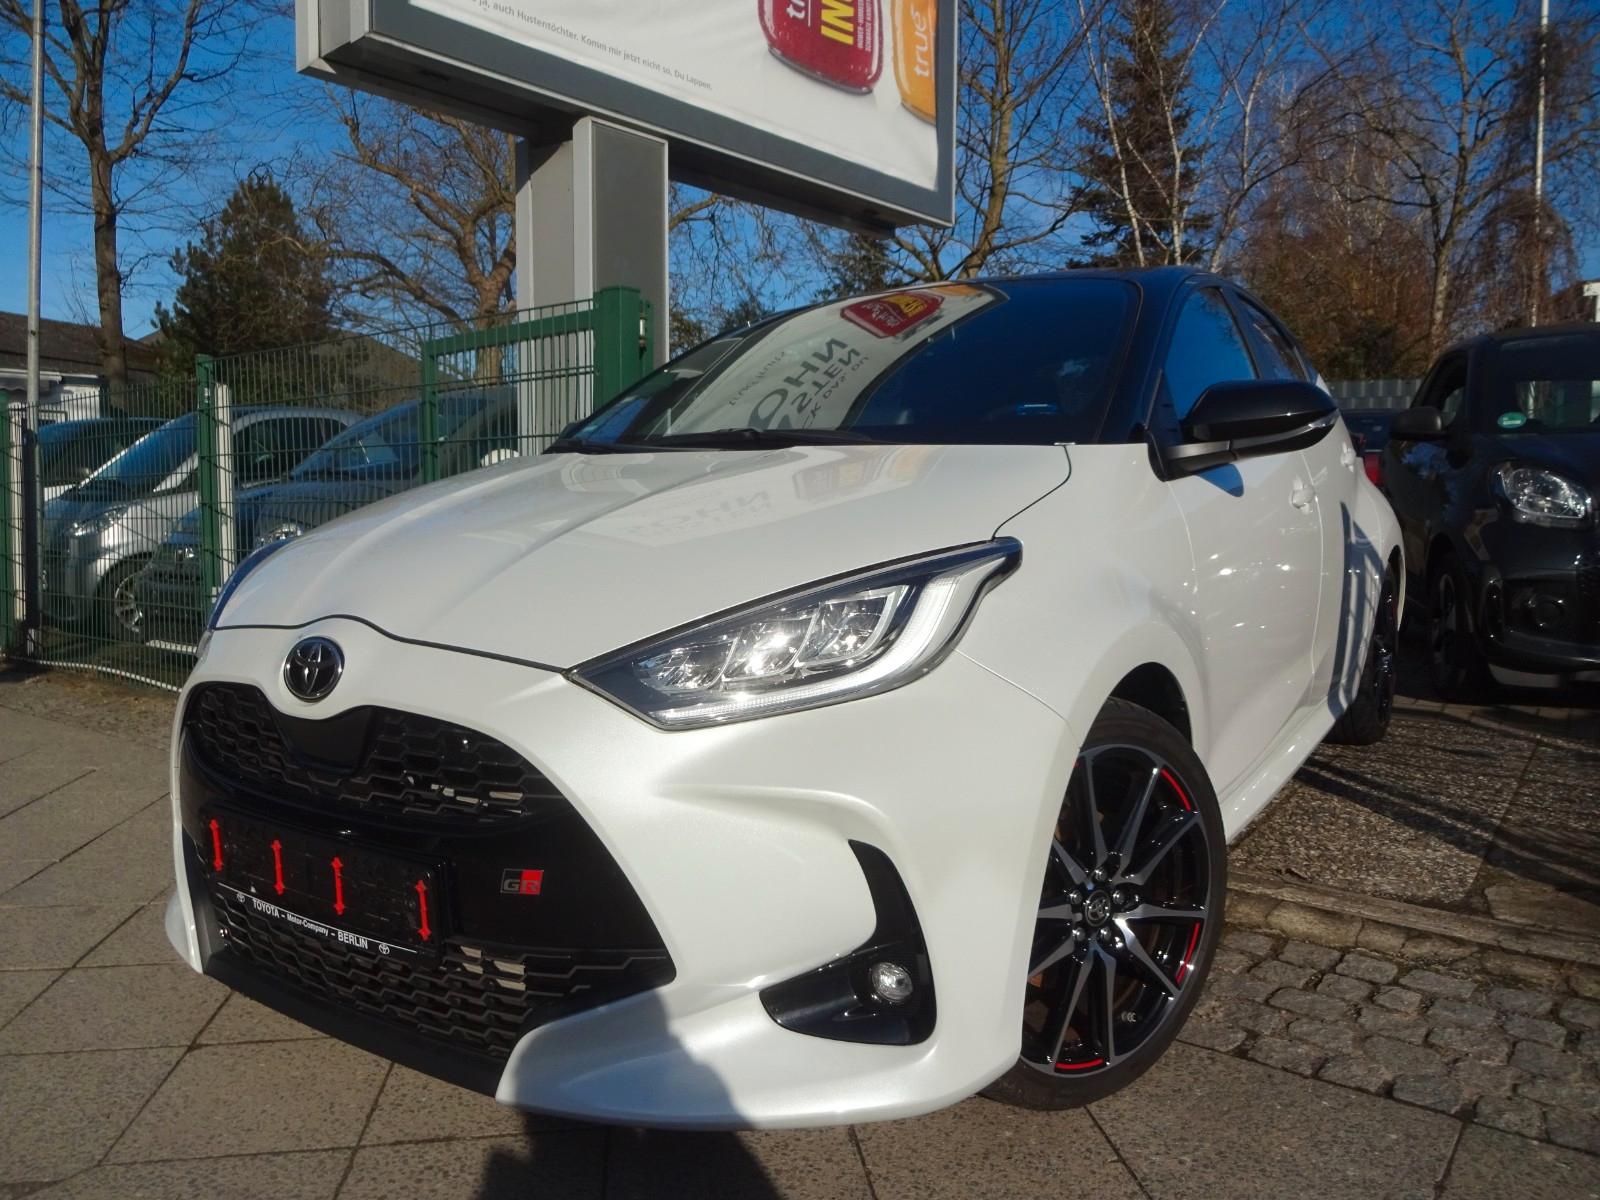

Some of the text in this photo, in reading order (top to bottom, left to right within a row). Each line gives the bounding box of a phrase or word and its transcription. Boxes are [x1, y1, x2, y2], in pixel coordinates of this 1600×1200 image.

[493, 2, 515, 17] auch
[516, 9, 579, 41] Hustentöchter.
[581, 34, 607, 51] Komm
[608, 45, 622, 57] mir
[623, 51, 641, 65] jetzt
[642, 58, 661, 72] nicht
[674, 69, 685, 80] Du
[821, 0, 854, 45] IN
[503, 879, 541, 893] GR
[252, 899, 280, 918] TOYOTA
[287, 913, 329, 937] Motor-Company
[338, 932, 368, 949] BERLIN
